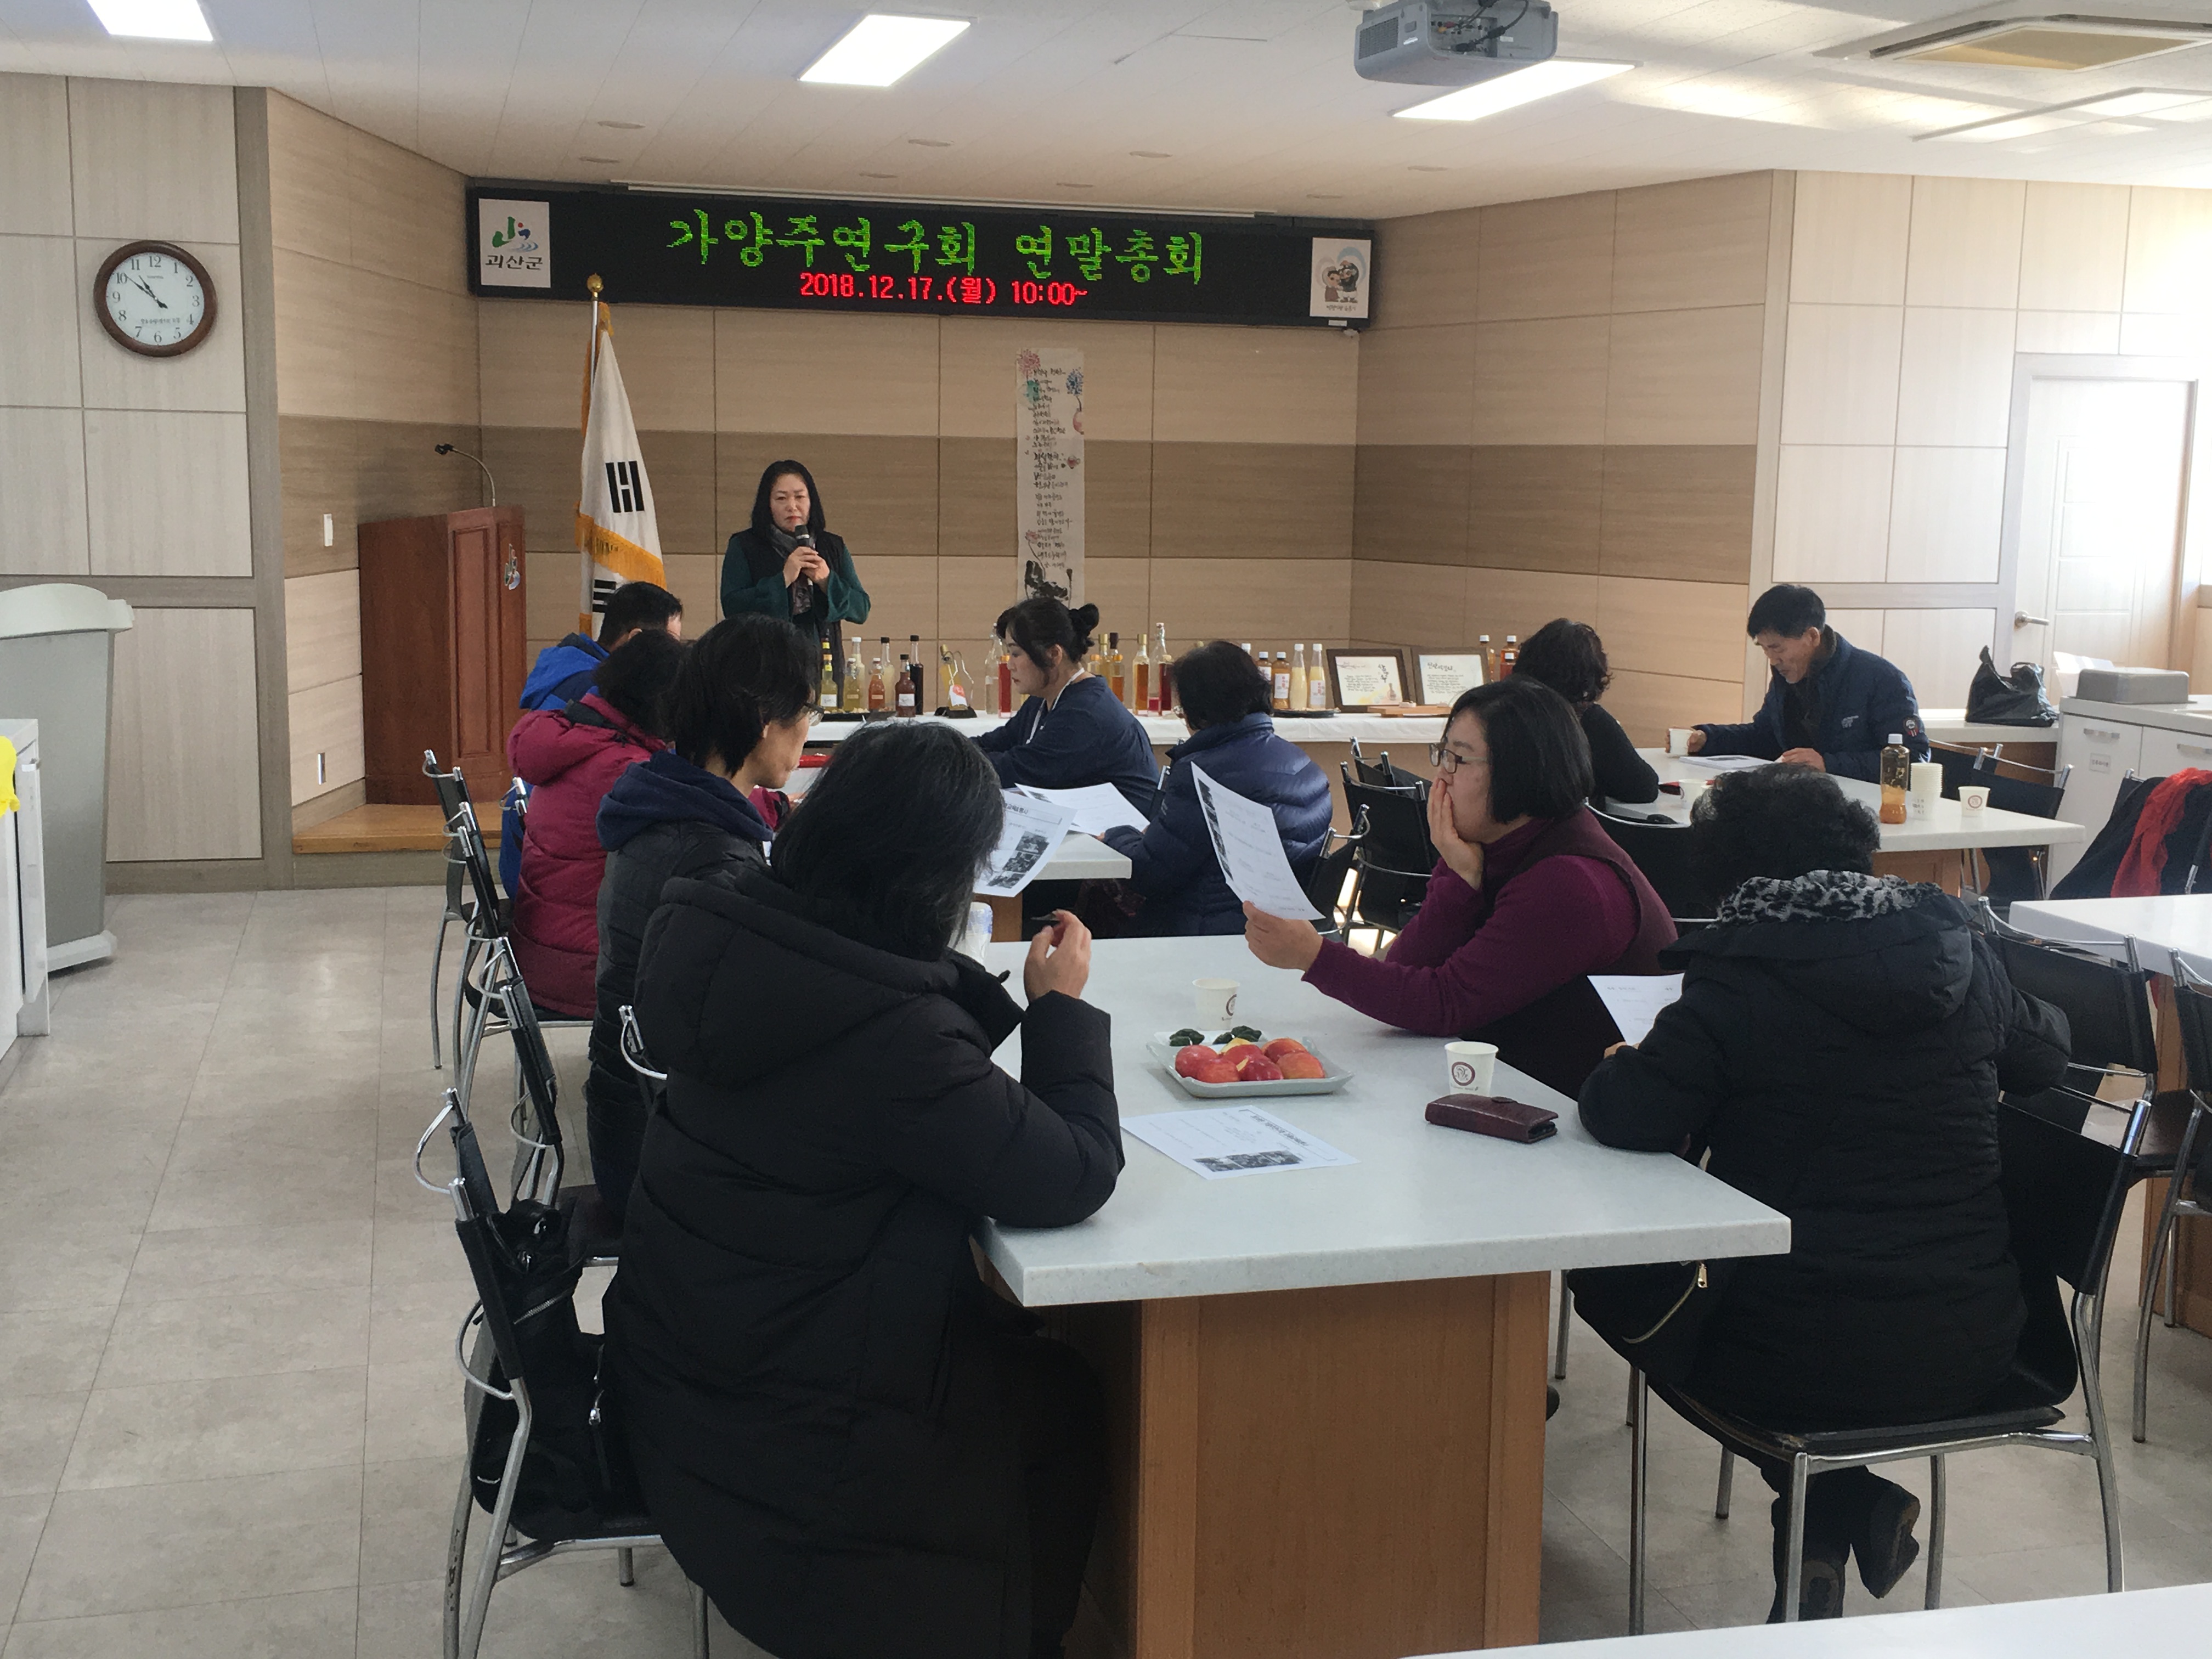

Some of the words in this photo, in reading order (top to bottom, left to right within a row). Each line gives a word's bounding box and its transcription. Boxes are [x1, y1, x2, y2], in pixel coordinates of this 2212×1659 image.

[667, 208, 976, 276] 가양주연구회
[1015, 225, 1203, 284] 연말총회
[131, 258, 140, 270] 11
[149, 255, 162, 268] 12
[485, 254, 543, 270] 괴산군
[173, 262, 178, 274] 1
[116, 272, 128, 284] 10
[185, 276, 193, 287] 2
[799, 272, 996, 304] 2018.12.17.(월)
[1011, 280, 1088, 306] 10:00~
[112, 291, 121, 303] 9
[192, 295, 200, 307] 3
[118, 309, 127, 321] 8
[188, 313, 194, 325] 4
[134, 326, 142, 338] 7
[154, 330, 162, 343] 6
[173, 328, 182, 340] 5
